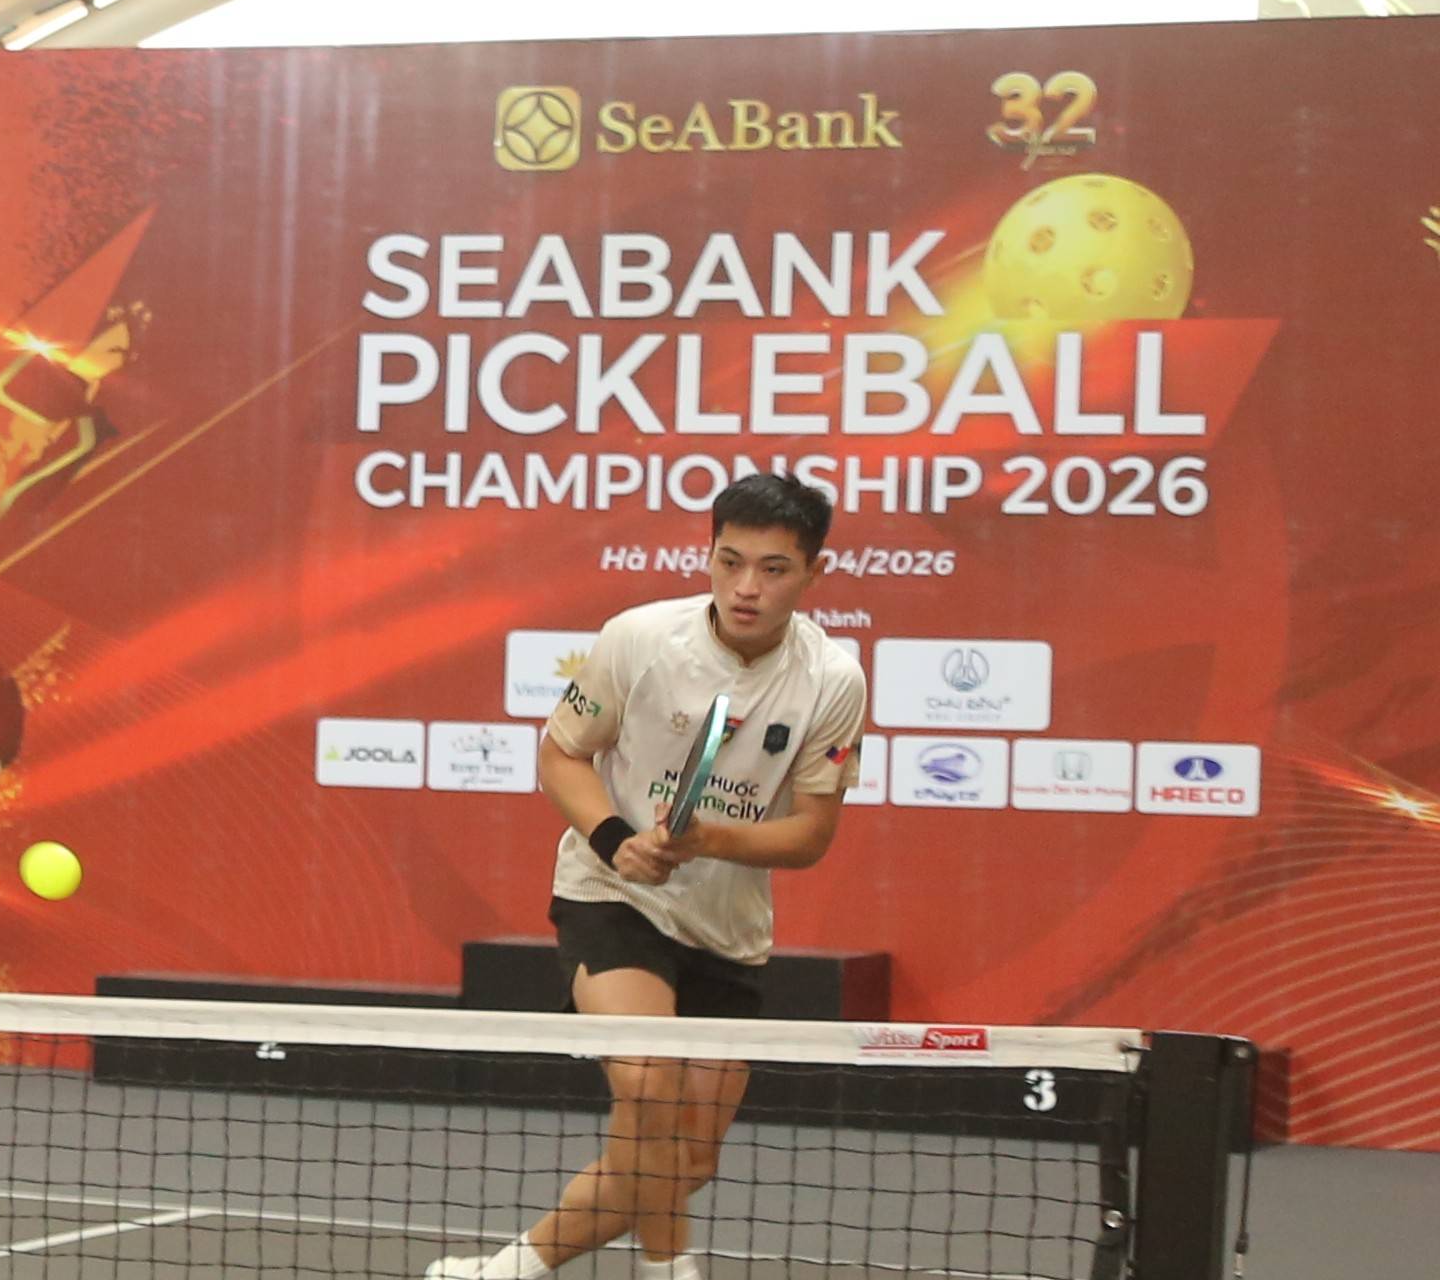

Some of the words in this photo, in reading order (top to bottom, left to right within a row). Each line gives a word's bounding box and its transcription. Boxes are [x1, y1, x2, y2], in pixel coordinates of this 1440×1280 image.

[595, 93, 903, 154] SeABank
[989, 70, 1099, 144] 32
[362, 231, 946, 319] SEABANK
[357, 332, 1207, 435] PICKLEBALL
[1001, 456, 1209, 516] 2026
[600, 546, 648, 571] Hà
[344, 746, 417, 764] JOOLA
[1023, 1069, 1058, 1112] 3
